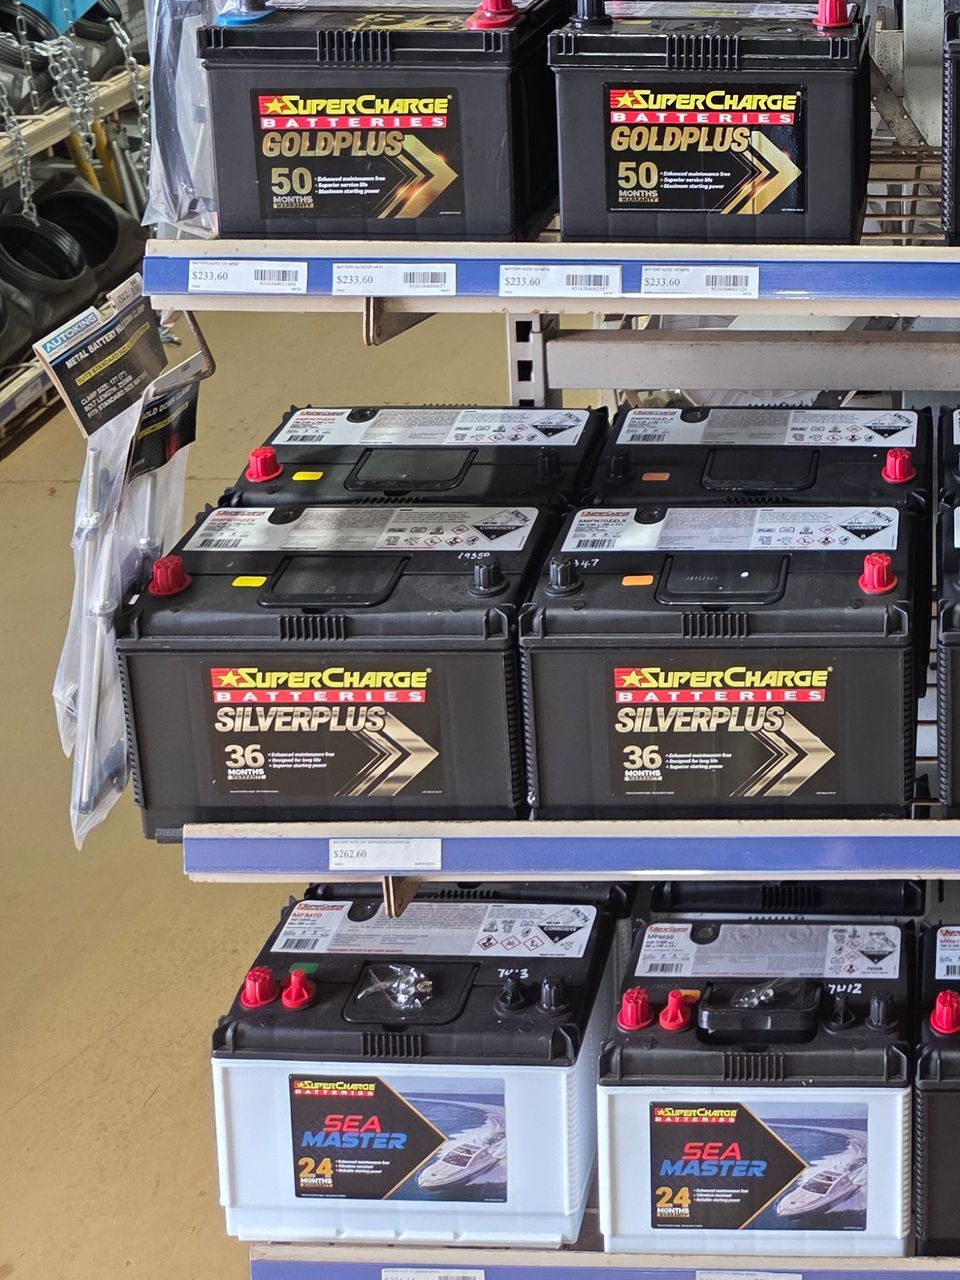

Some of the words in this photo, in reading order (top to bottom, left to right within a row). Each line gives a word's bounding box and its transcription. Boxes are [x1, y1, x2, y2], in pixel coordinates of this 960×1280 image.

[281, 95, 448, 114] SUPERCHARGE
[633, 90, 796, 110] SUPERCHARGE
[263, 117, 444, 127] BATTERIES
[613, 113, 791, 122] BATTERIES
[263, 131, 404, 157] GOLDPLUS
[611, 126, 750, 152] GOLDPLUS
[271, 167, 312, 195] 50
[618, 162, 658, 189] 50
[192, 271, 228, 281] $233.60
[337, 275, 373, 284] $233.60
[505, 277, 540, 286] $233.60
[645, 277, 680, 287] $233.60
[46, 314, 97, 352] AUTOKING
[65, 350, 89, 369] METAL
[238, 668, 427, 688] SUPERCHARGE
[216, 691, 423, 702] BATTERIES
[618, 691, 822, 702] BATTERIES
[215, 706, 384, 732] SILVERPLUS
[615, 706, 784, 732] SILVERPLUS
[225, 744, 264, 767] 36
[623, 745, 662, 769] 36
[323, 1114, 381, 1132] SEA
[301, 1131, 407, 1149] MASTER
[682, 1142, 741, 1160] SEA
[299, 1158, 333, 1177] 24
[659, 1160, 767, 1177] MASTER
[656, 1187, 691, 1207] 24
